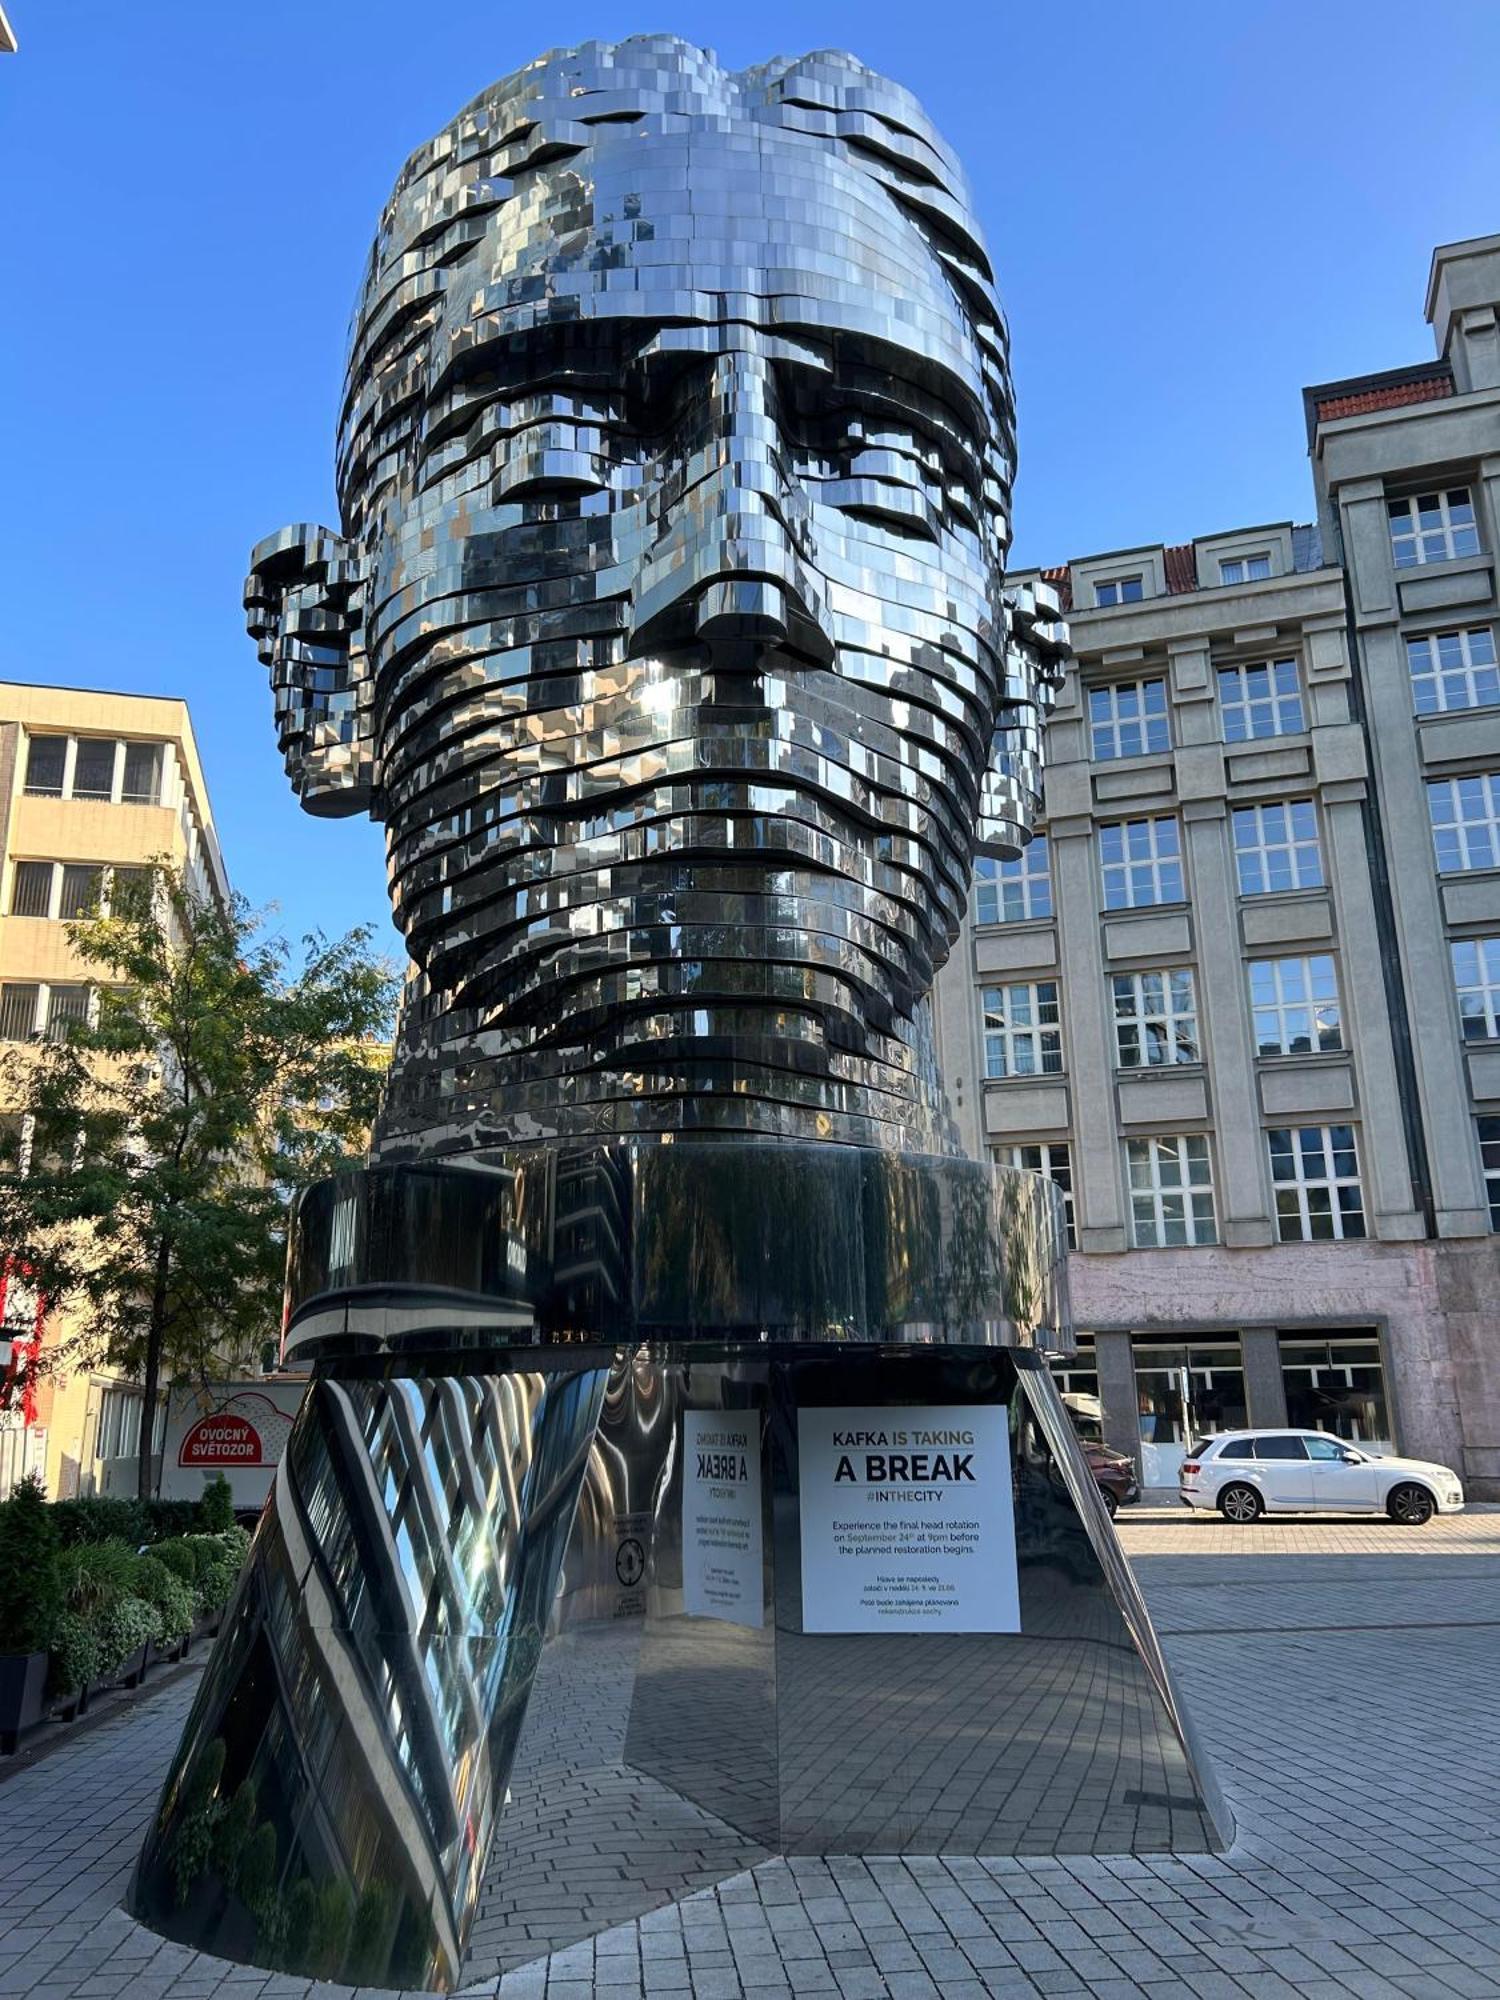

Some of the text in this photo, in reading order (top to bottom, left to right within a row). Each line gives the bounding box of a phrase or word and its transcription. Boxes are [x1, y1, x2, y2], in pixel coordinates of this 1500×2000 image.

[200, 1426, 249, 1440] OVOCNÝ
[833, 1430, 974, 1446] KAFKA IS TAKING
[192, 1441, 254, 1456] SVĚTOZOR
[834, 1454, 976, 1481] A BREAK
[867, 1490, 943, 1502] #INTHECITY
[832, 1520, 980, 1531] Experience the final head rotation
[834, 1534, 845, 1542] on
[847, 1532, 897, 1543] September
[916, 1533, 926, 1541] at
[928, 1533, 949, 1543] 9pm
[950, 1533, 980, 1541] before
[839, 1545, 854, 1555] the
[855, 1545, 892, 1556] planned
[894, 1545, 941, 1555] restoration
